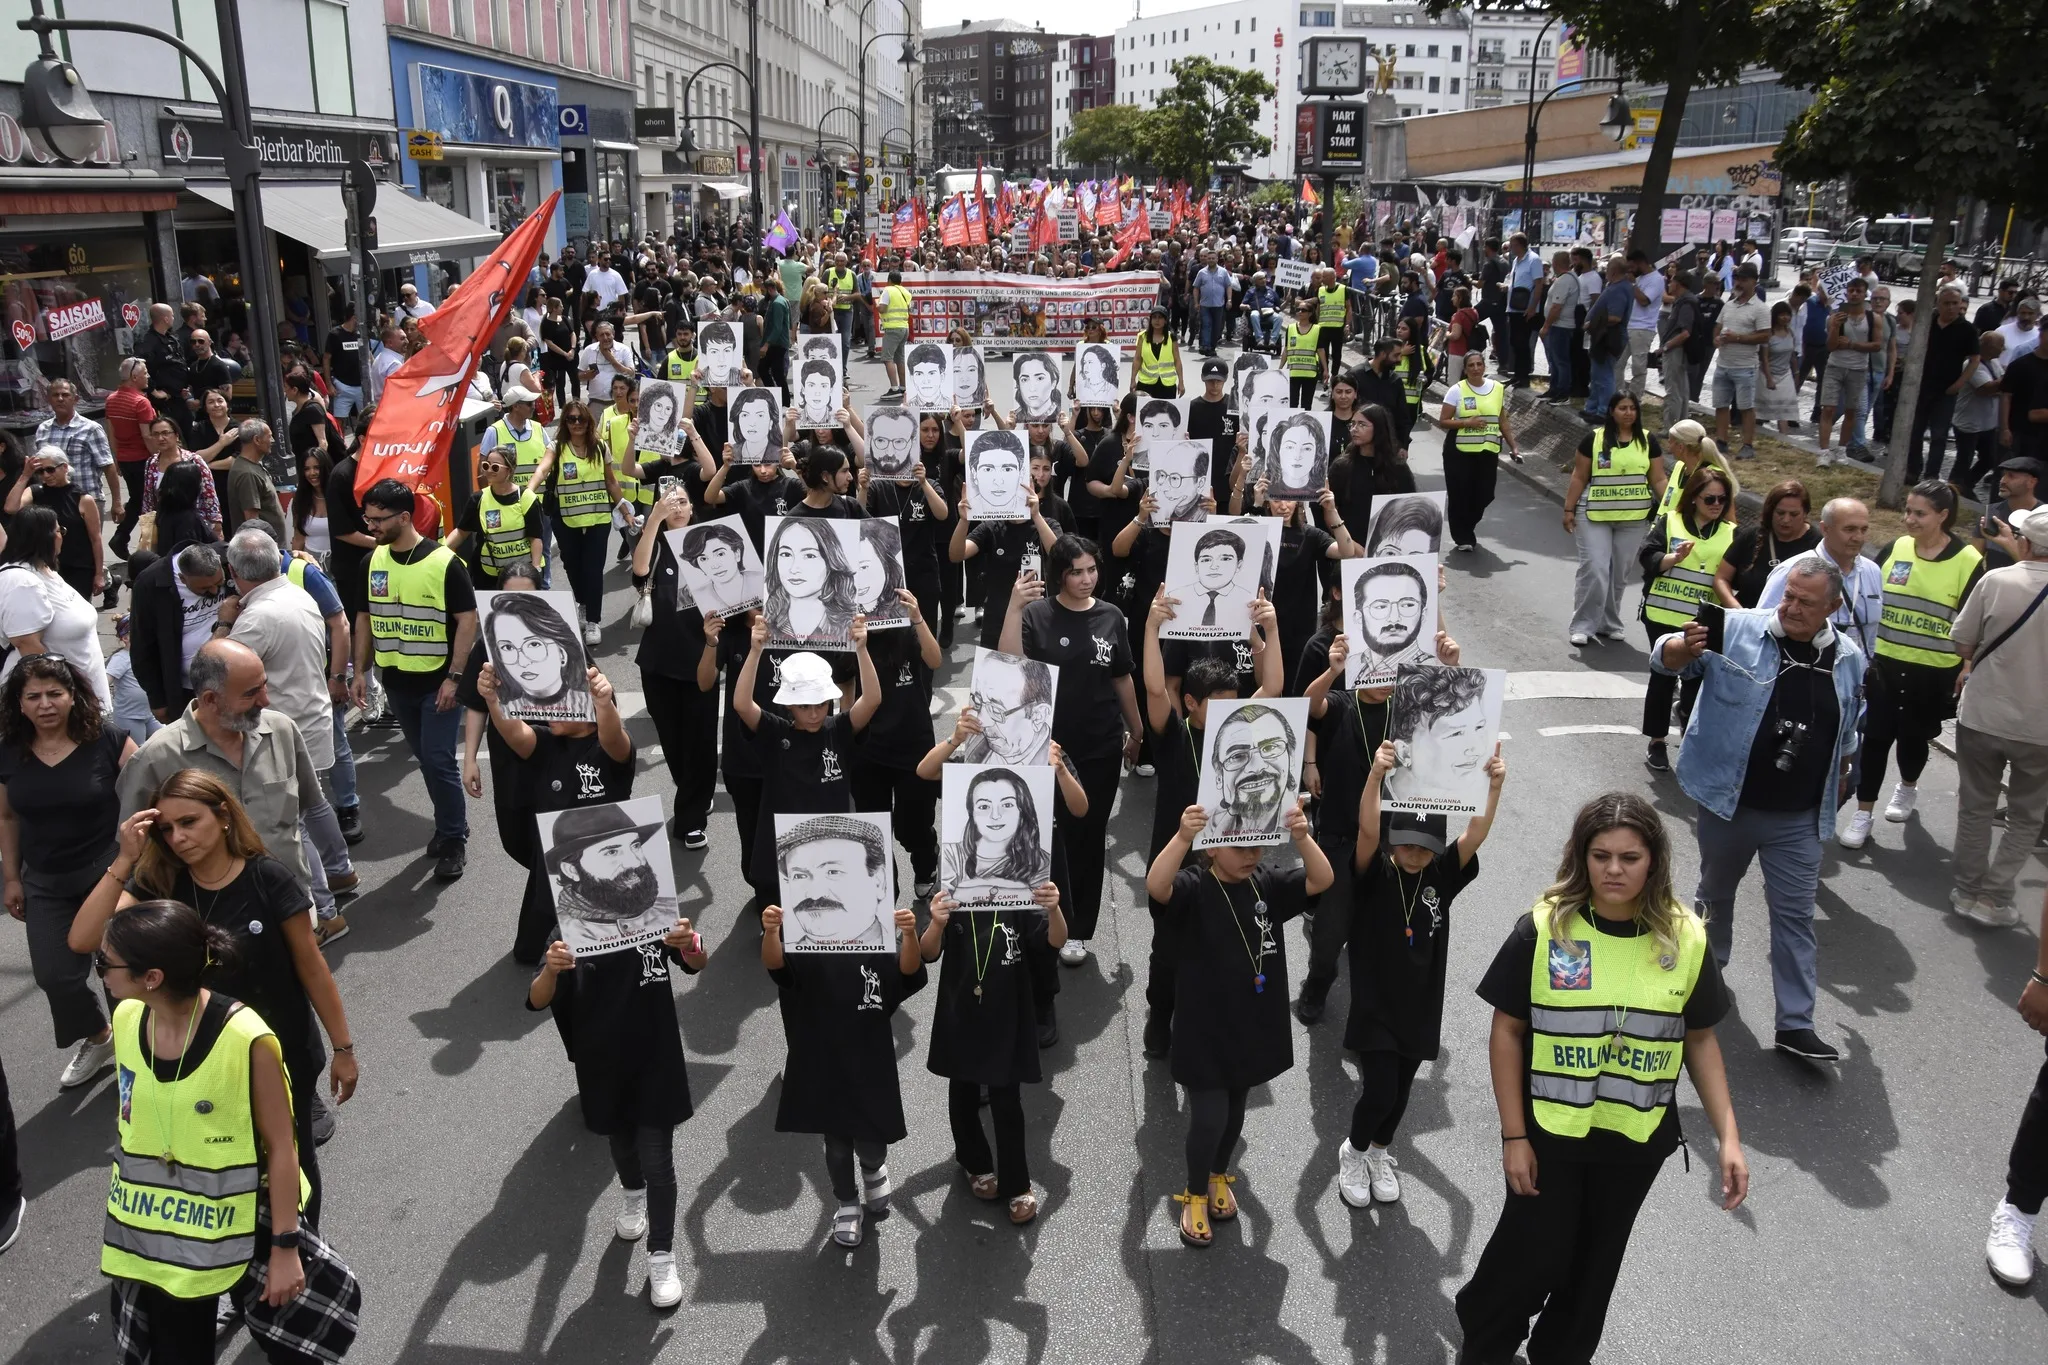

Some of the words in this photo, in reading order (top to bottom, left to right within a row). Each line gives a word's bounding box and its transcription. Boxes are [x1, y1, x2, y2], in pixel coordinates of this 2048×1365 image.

[1332, 110, 1356, 121] HART
[1335, 123, 1351, 134] AM
[1330, 136, 1356, 147] START
[253, 136, 303, 162] Bierbar
[305, 139, 343, 163] Berlin
[409, 149, 432, 157] CASH
[69, 247, 86, 264] 60
[69, 265, 91, 275] JAHRE
[49, 300, 104, 330] SAISON
[124, 310, 138, 322] 20%
[16, 327, 32, 342] 50%
[1592, 487, 1648, 498] BERLIN-CEMEVI
[1167, 630, 1242, 638] ONURUMUZDUR
[771, 639, 848, 649] ONURUMUZDUR
[510, 710, 588, 719] ONURUMUZDUR
[1391, 801, 1477, 813] ONURUMUZDUR
[1201, 833, 1282, 845] ONURUMUZDUR
[575, 926, 671, 953] ONURUMUZDUR
[599, 934, 617, 942] ASAF
[1553, 1044, 1673, 1073] BERLIN-CEMEVI
